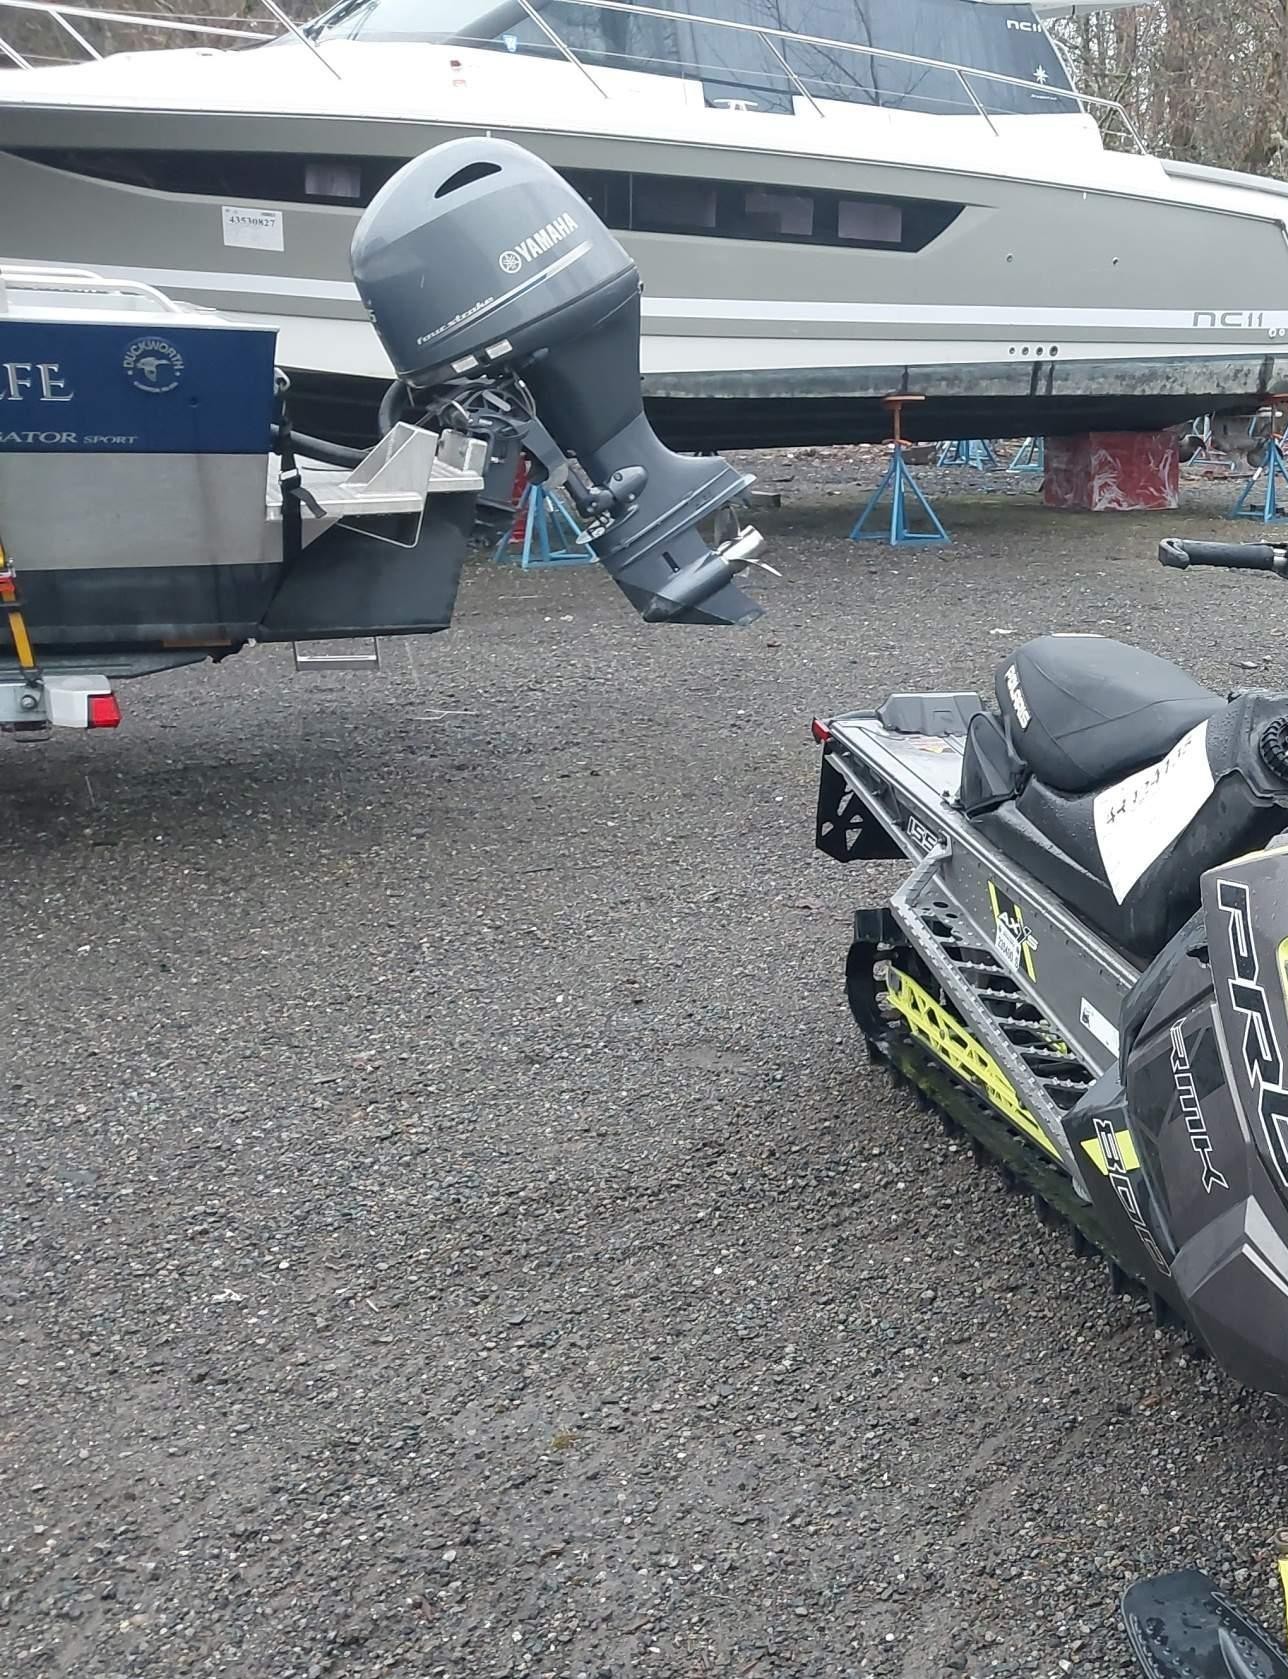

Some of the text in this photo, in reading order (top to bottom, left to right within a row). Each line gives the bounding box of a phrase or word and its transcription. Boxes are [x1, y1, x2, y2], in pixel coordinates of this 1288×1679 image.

[513, 212, 579, 263] YAMAHA
[123, 339, 185, 369] DUCKWORTH
[0, 362, 75, 402] FE
[83, 434, 138, 445] SPORT
[1004, 664, 1033, 729] POLARIS
[1169, 1016, 1230, 1194] RMK
